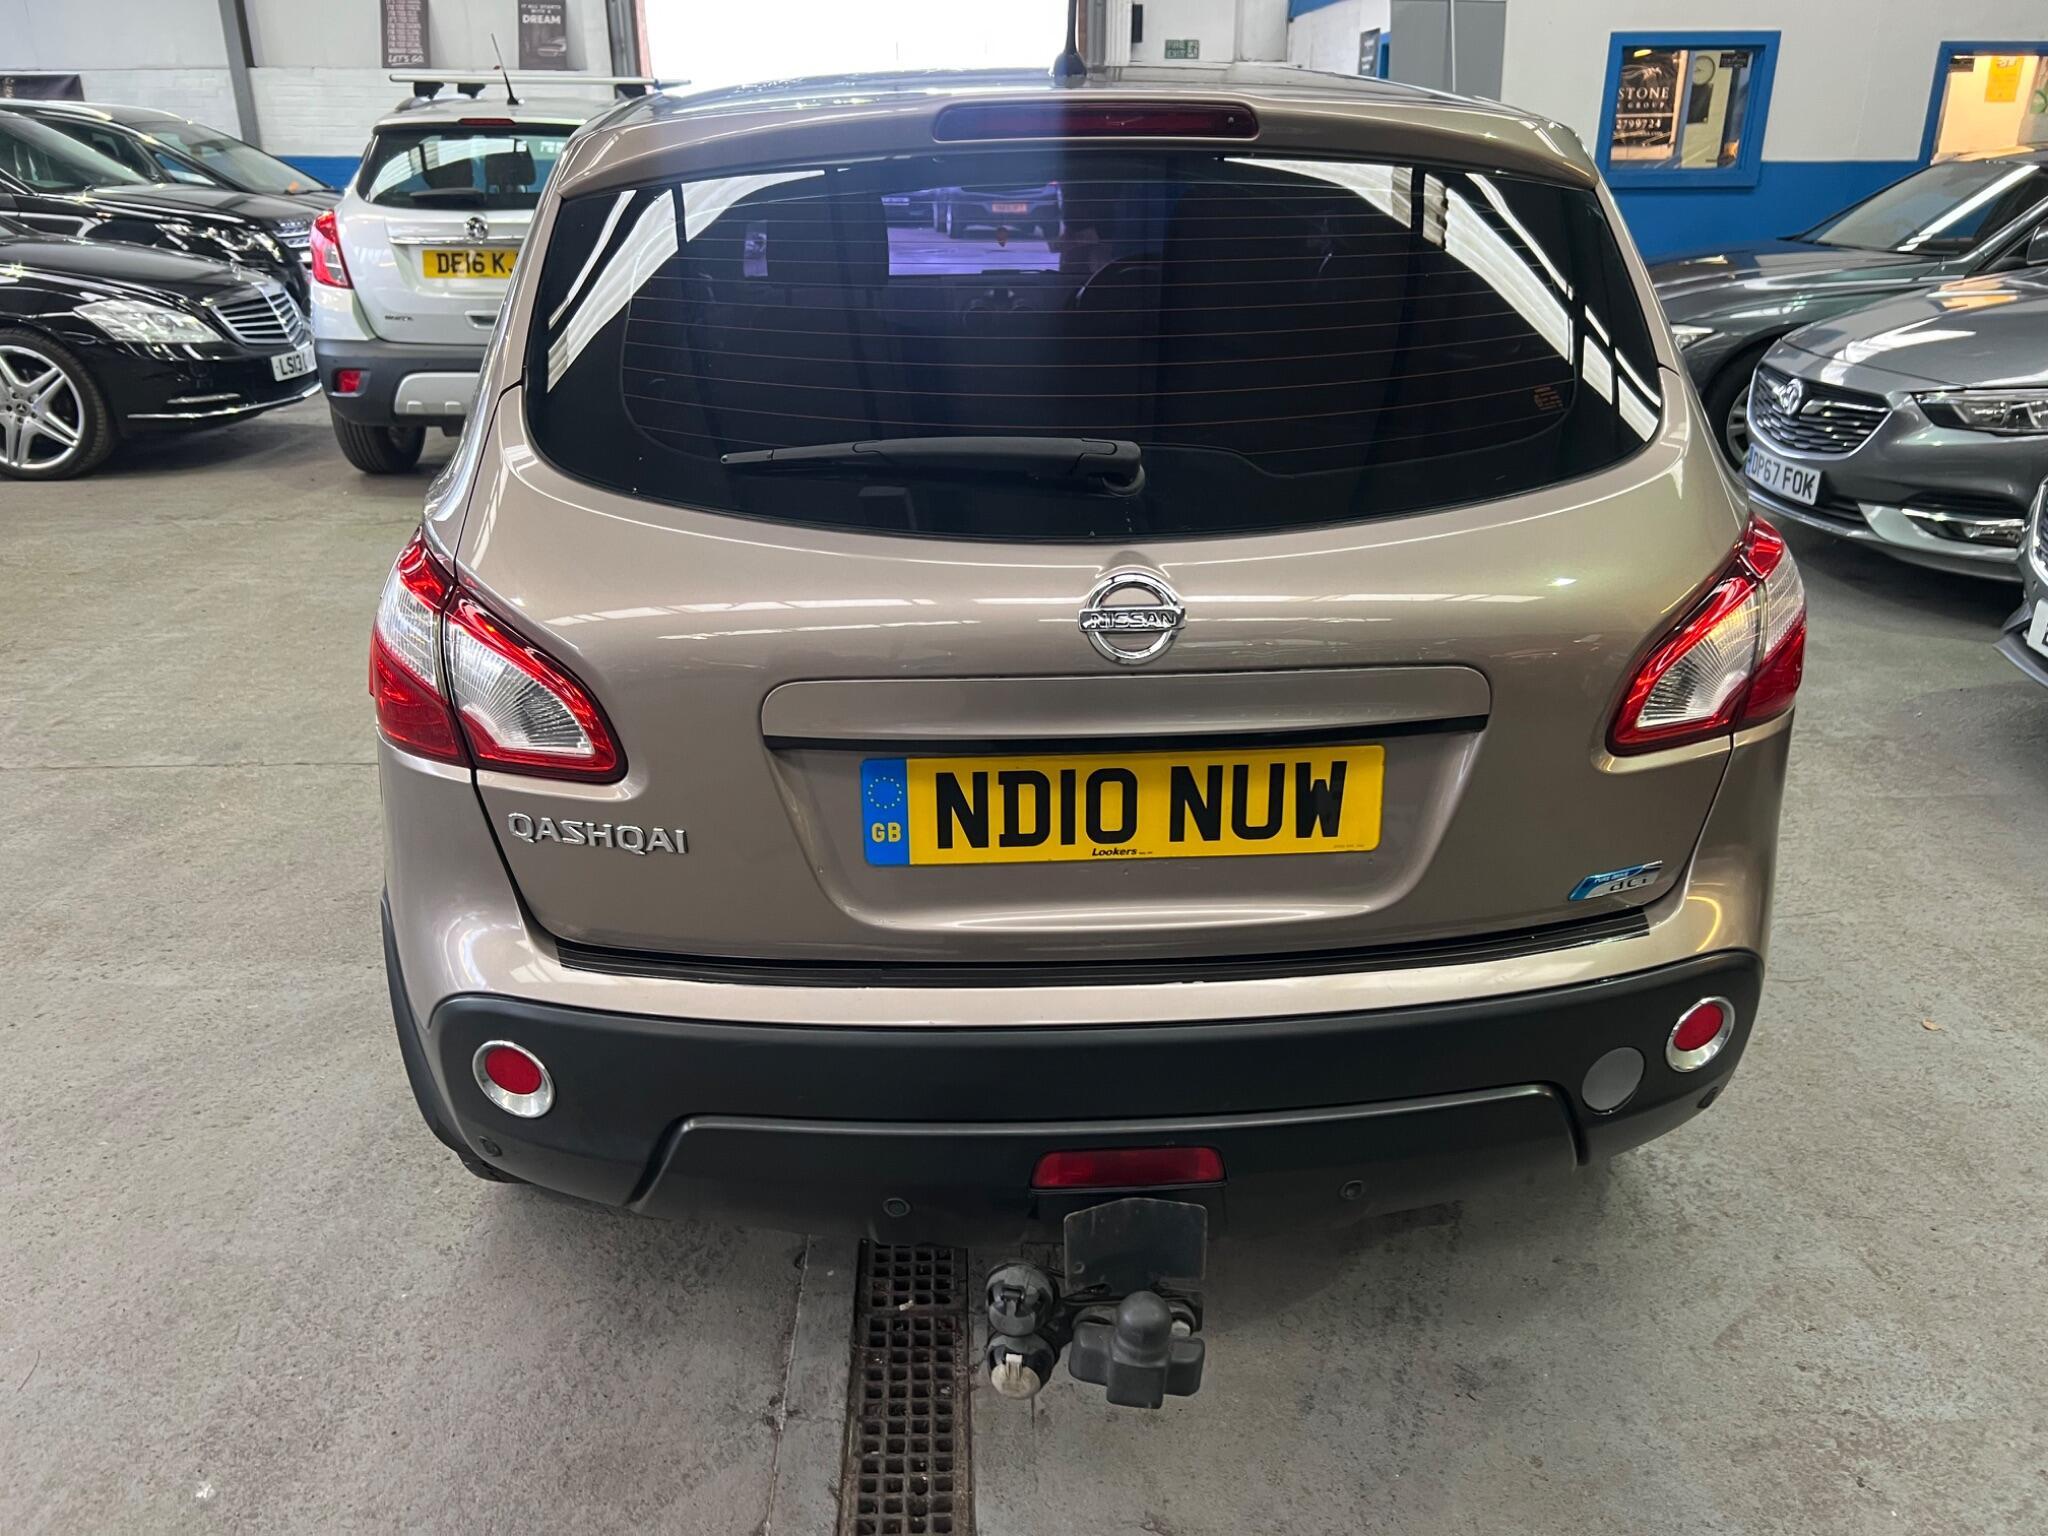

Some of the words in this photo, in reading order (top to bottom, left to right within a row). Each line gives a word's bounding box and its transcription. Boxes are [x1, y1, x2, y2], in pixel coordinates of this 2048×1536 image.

[522, 14, 562, 25] DREAM
[411, 54, 424, 63] GO
[1618, 87, 1670, 100] STONE
[1627, 101, 1665, 109] GROUP
[436, 252, 485, 274] DE16
[1751, 451, 1781, 485] DP67
[1782, 466, 1816, 500] FOK
[1090, 611, 1177, 629] NISSAN
[935, 767, 1138, 850] ND10
[1169, 760, 1348, 843] NUW
[507, 812, 689, 856] QASHQAI
[871, 822, 901, 844] GB
[1092, 847, 1137, 857] Lookers
